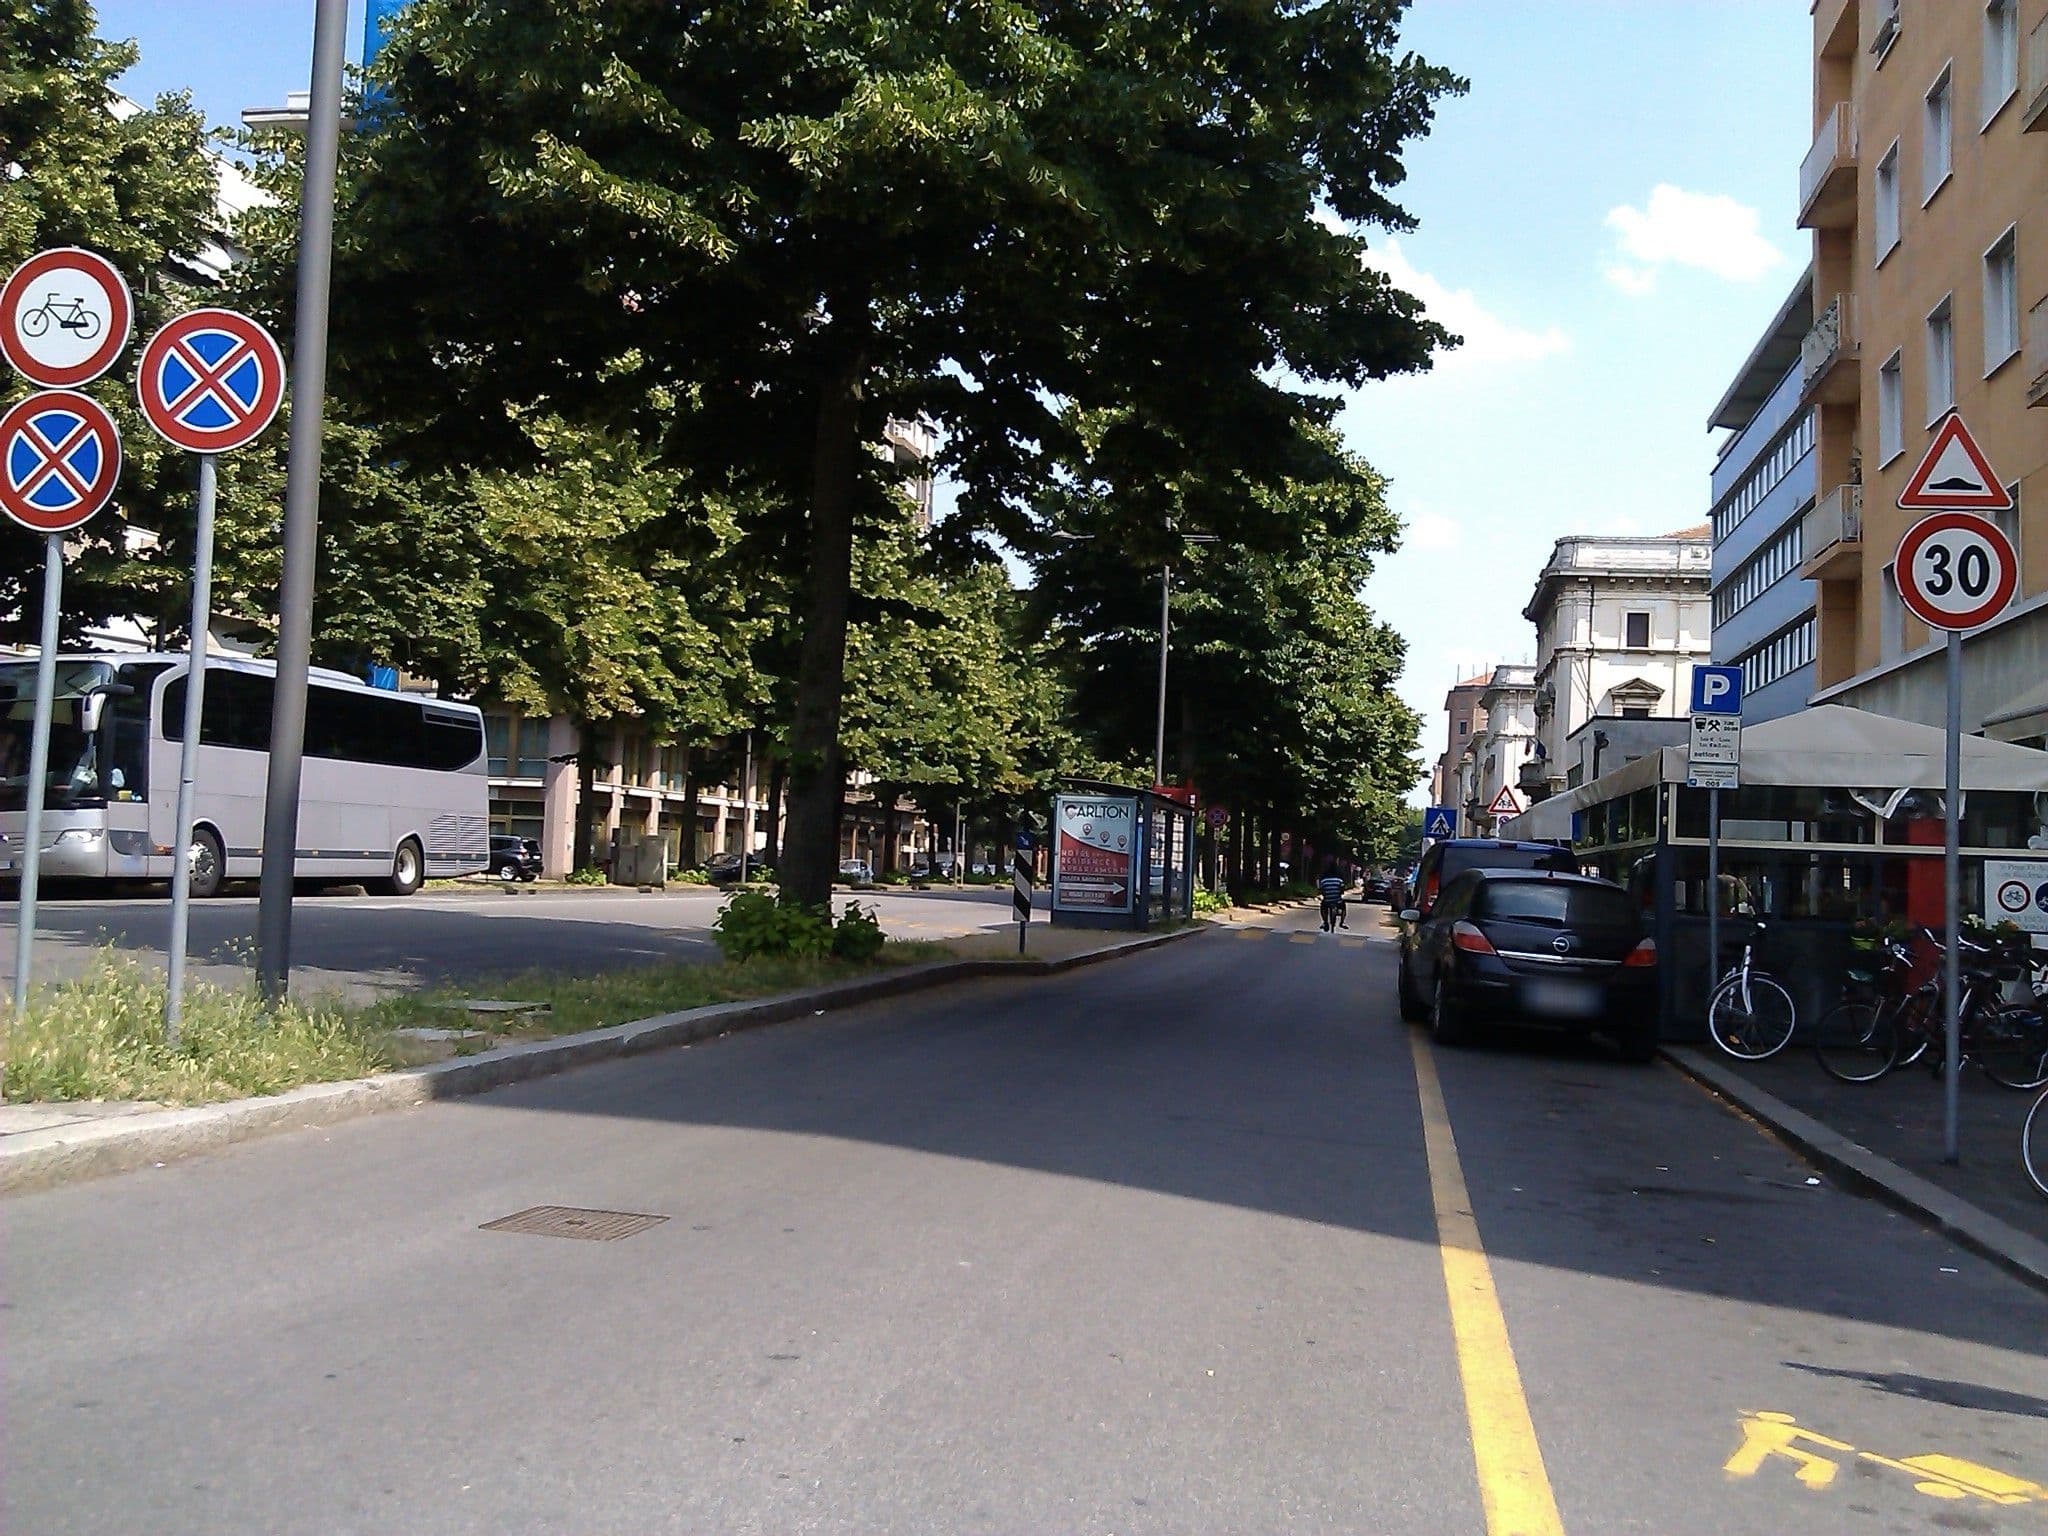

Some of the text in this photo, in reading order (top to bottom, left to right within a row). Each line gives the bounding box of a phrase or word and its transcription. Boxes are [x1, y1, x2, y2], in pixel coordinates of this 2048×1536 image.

[1925, 544, 1990, 598] 30
[1703, 674, 1731, 705] P
[1065, 804, 1129, 819] CARLTON
